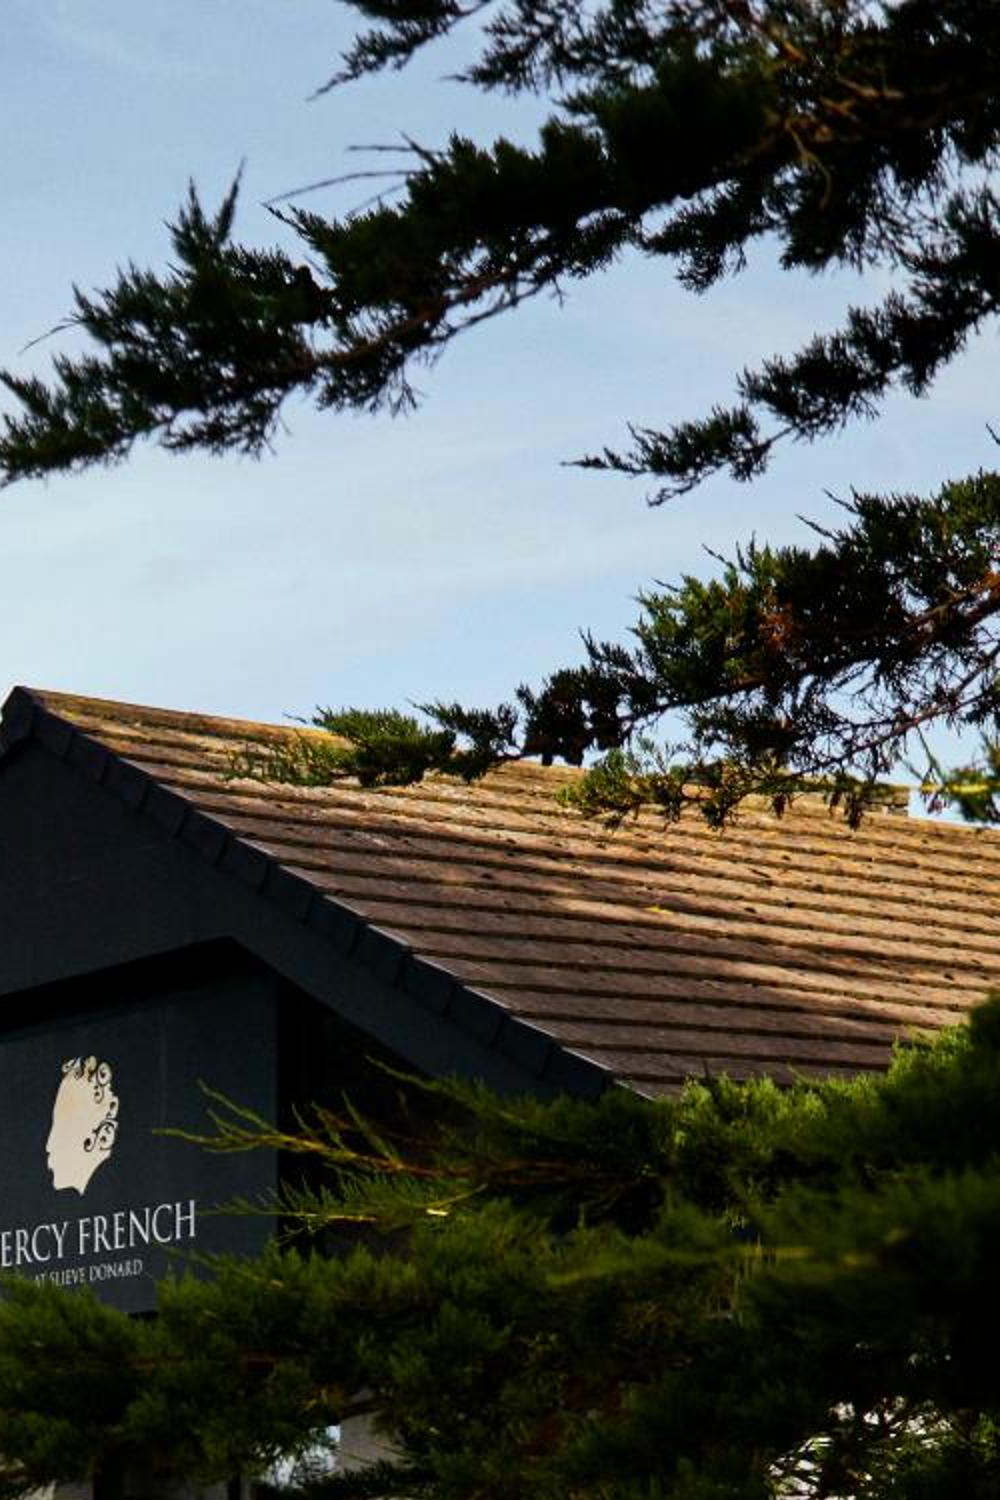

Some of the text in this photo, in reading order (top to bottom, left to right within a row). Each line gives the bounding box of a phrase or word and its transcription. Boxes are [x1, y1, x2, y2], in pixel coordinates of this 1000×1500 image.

[78, 1200, 196, 1255] FRENCH
[49, 1267, 86, 1286] SLIEVE
[89, 1259, 143, 1281] DONARD
